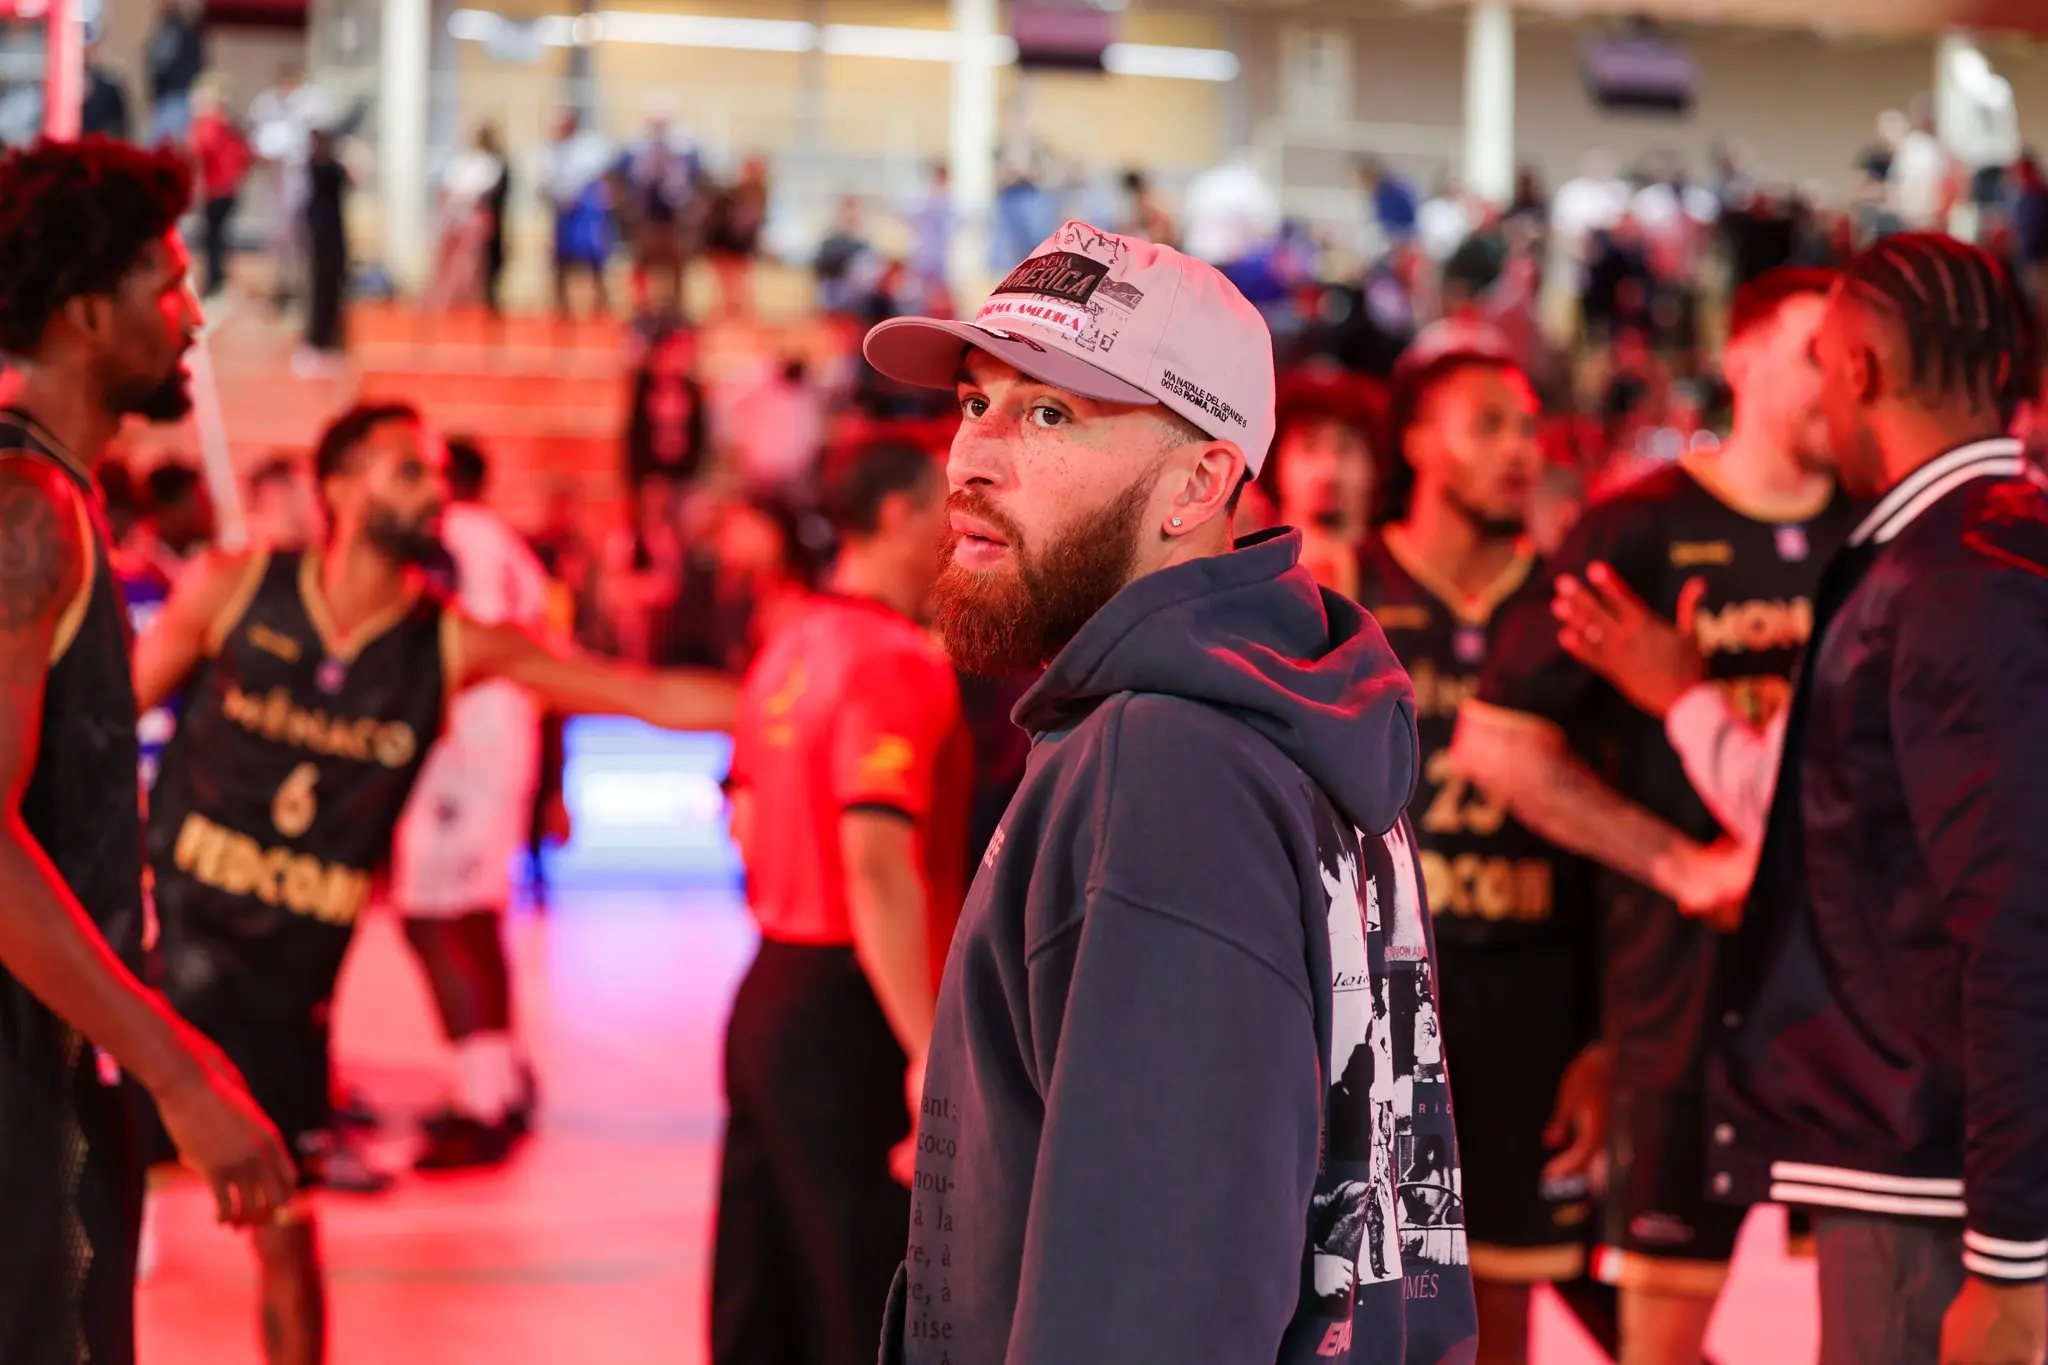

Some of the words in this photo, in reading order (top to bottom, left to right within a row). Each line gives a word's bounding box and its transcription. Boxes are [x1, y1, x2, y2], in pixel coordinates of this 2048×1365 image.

[998, 266, 1096, 297] AMERICA
[1016, 303, 1080, 332] AMERICA
[1161, 378, 1183, 396] 00153
[1183, 391, 1210, 413] ROMA,
[1210, 406, 1229, 423] ITALY
[1163, 369, 1176, 384] VIA
[1176, 377, 1205, 399] NATALE
[1206, 393, 1219, 407] DEL
[1220, 402, 1243, 425] GRANDE
[271, 762, 319, 837] 6
